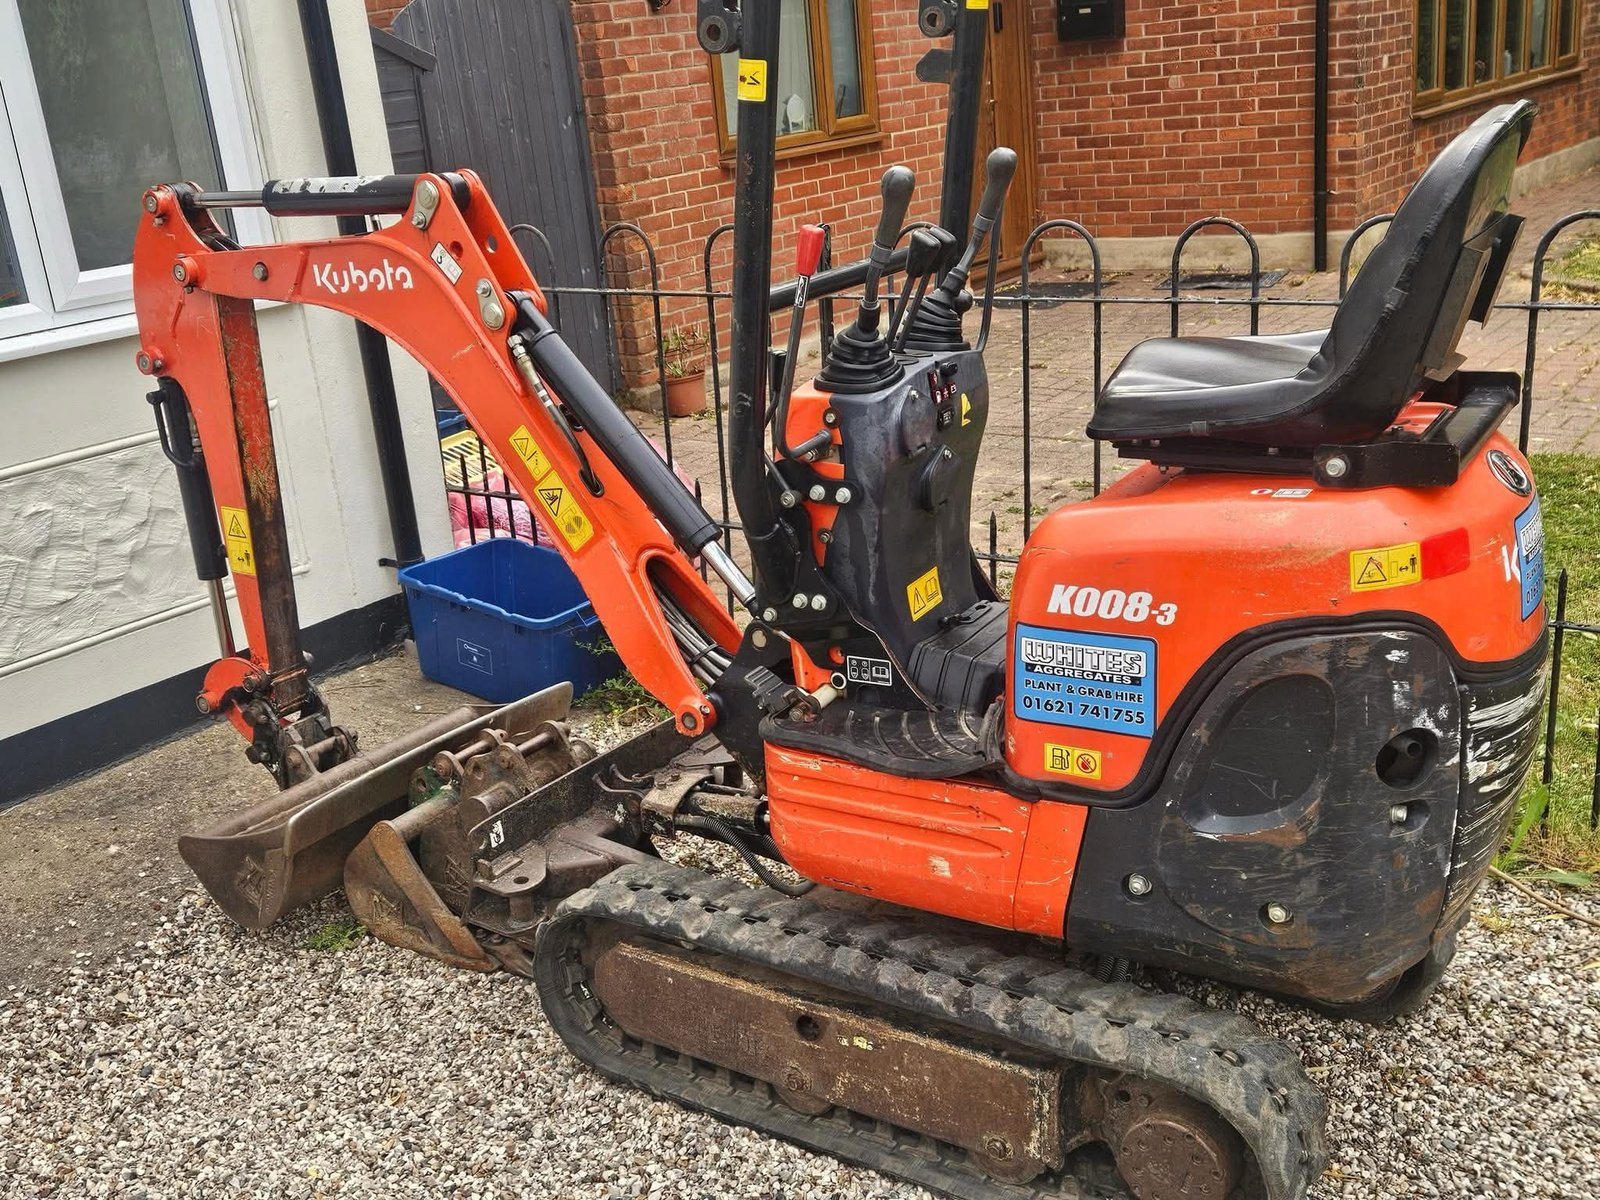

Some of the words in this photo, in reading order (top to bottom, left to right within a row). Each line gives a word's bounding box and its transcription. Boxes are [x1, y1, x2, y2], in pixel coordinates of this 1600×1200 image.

[312, 258, 414, 294] Kubota
[1046, 584, 1178, 626] K008-3
[1024, 639, 1142, 675] WHITES
[1033, 664, 1132, 684] AGGREGATES
[1024, 679, 1061, 692] PLANT
[1066, 685, 1075, 695] &
[1078, 686, 1112, 699] GRAB
[1115, 691, 1143, 703] HIRE
[1023, 695, 1073, 714] 01621
[1079, 703, 1145, 724] 741755
